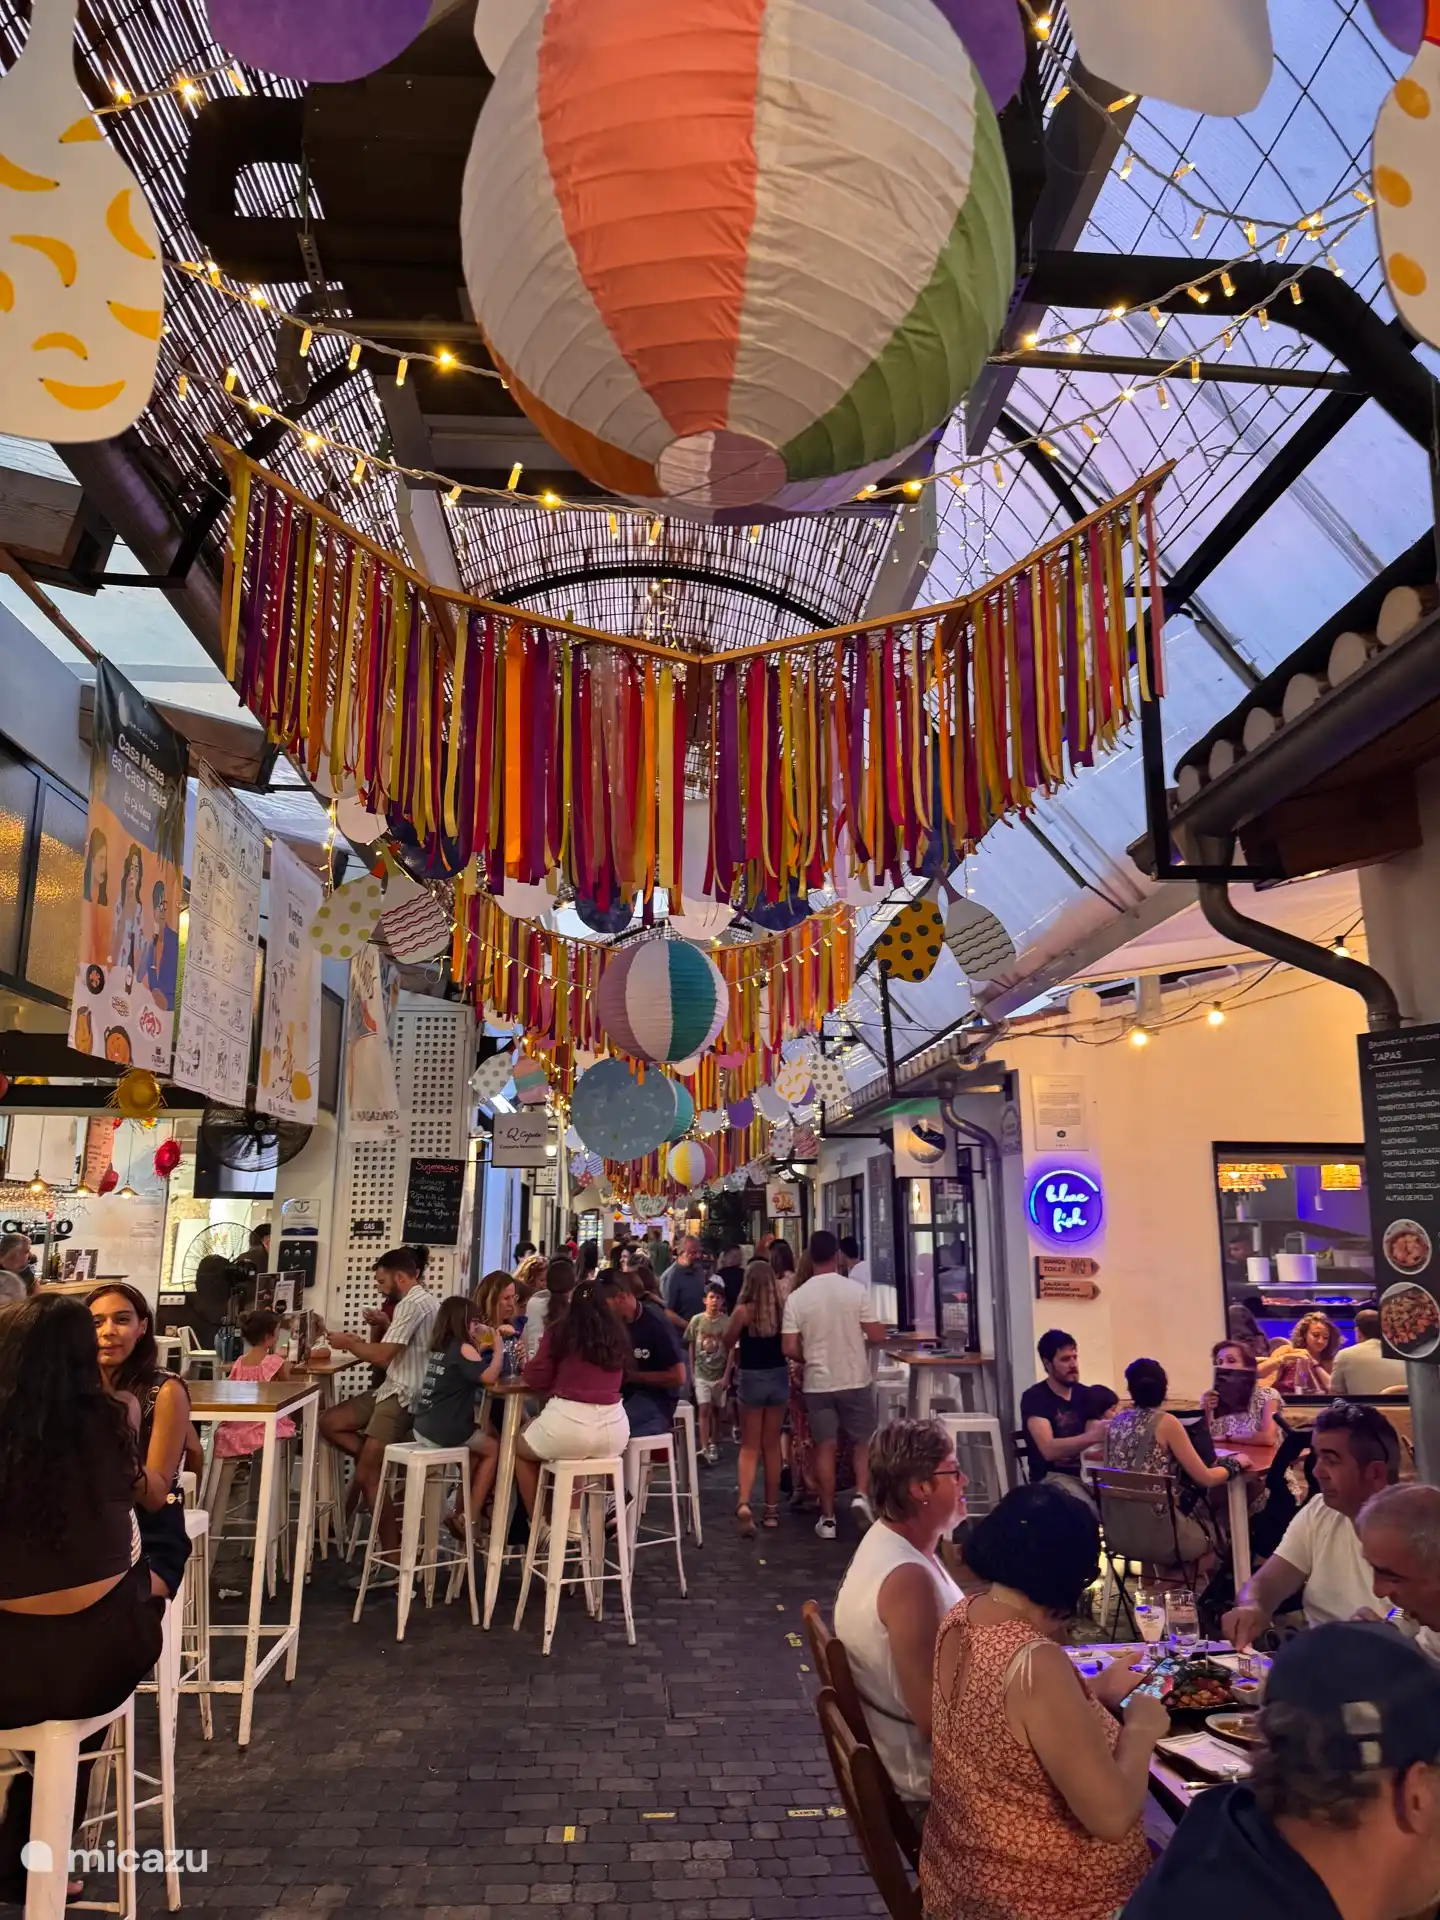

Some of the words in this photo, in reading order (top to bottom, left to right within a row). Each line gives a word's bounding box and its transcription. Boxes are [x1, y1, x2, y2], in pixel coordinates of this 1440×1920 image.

[111, 749, 123, 773] és
[124, 762, 146, 793] Casa
[118, 733, 141, 765] Casa
[141, 753, 165, 786] Meua
[1372, 1050, 1403, 1062] TAPAS
[1045, 1183, 1089, 1203] blue
[1053, 1207, 1087, 1233] fish
